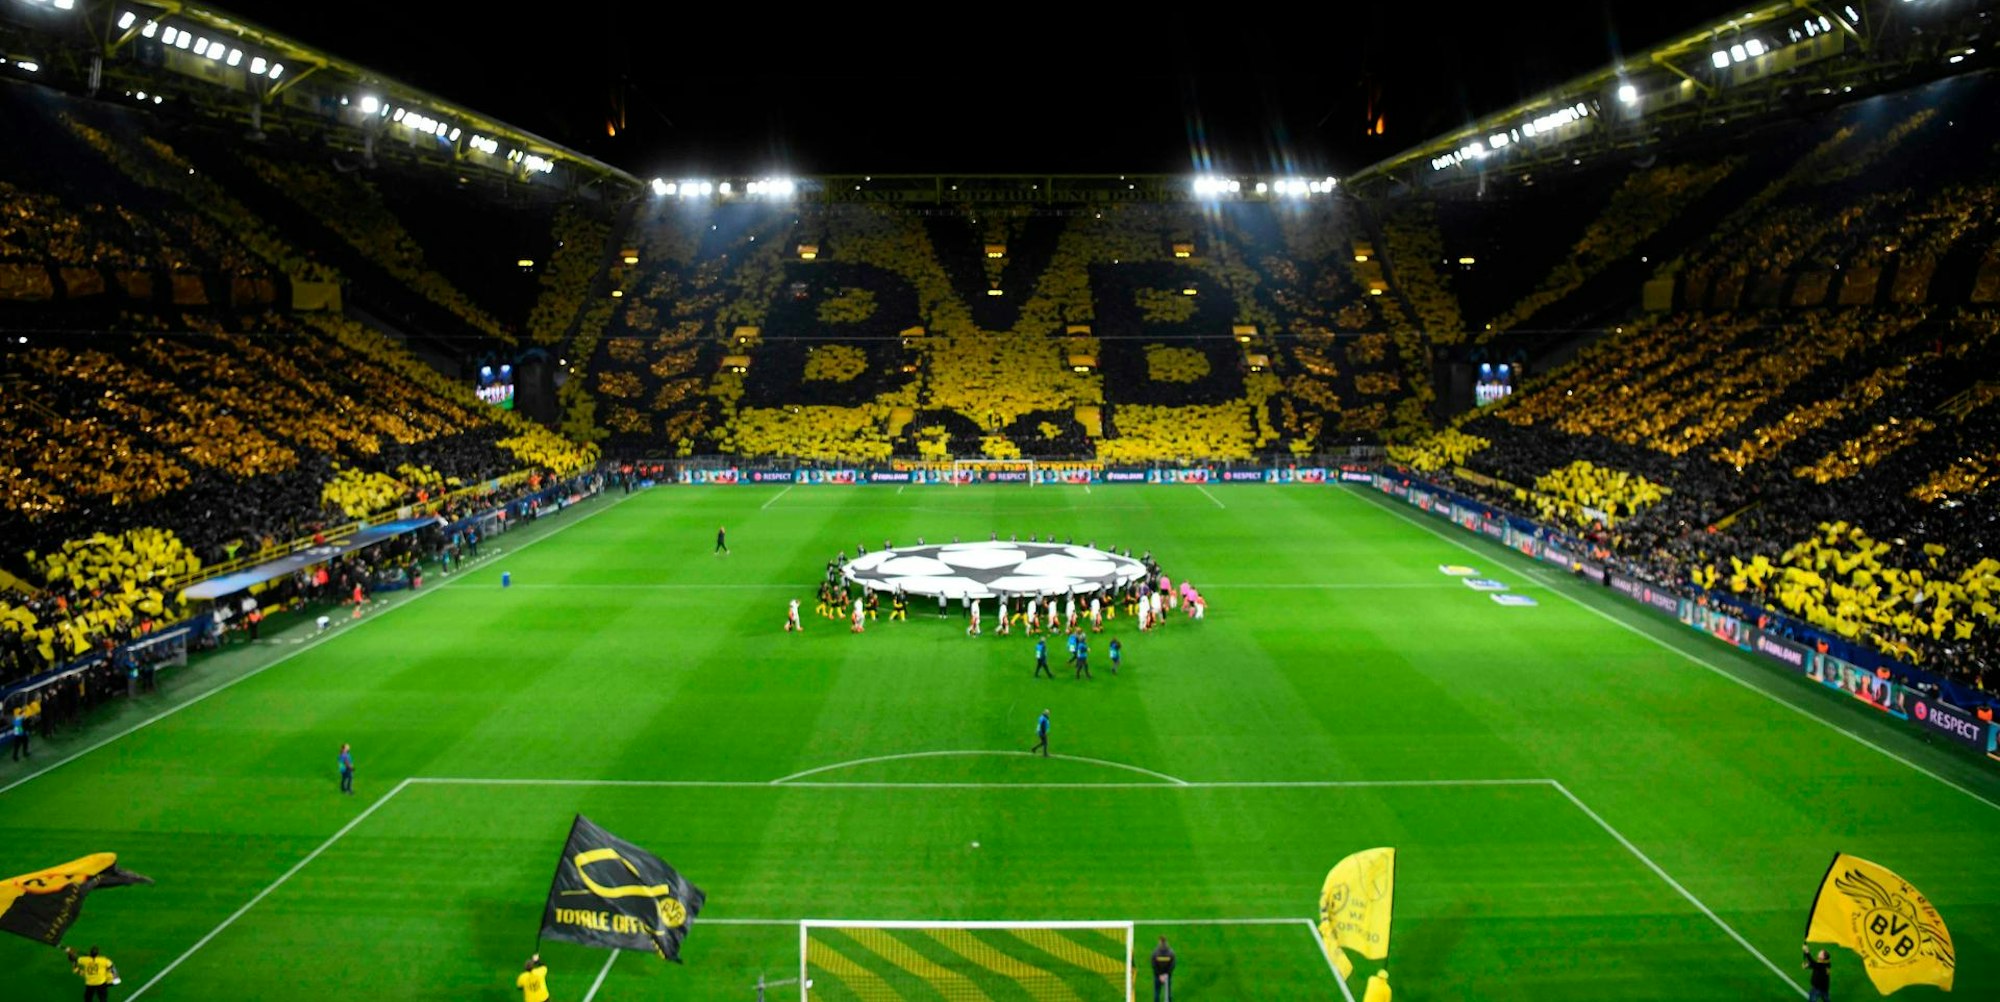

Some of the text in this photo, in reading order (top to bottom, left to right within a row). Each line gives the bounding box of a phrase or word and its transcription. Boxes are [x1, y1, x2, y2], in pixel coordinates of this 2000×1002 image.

[745, 203, 1250, 408] BVB
[1233, 472, 1261, 480] RESPECT
[1930, 708, 1980, 741] RESPECT
[556, 908, 610, 932] TOTALE
[1870, 914, 1914, 957] BVB
[1875, 939, 1891, 956] 09
